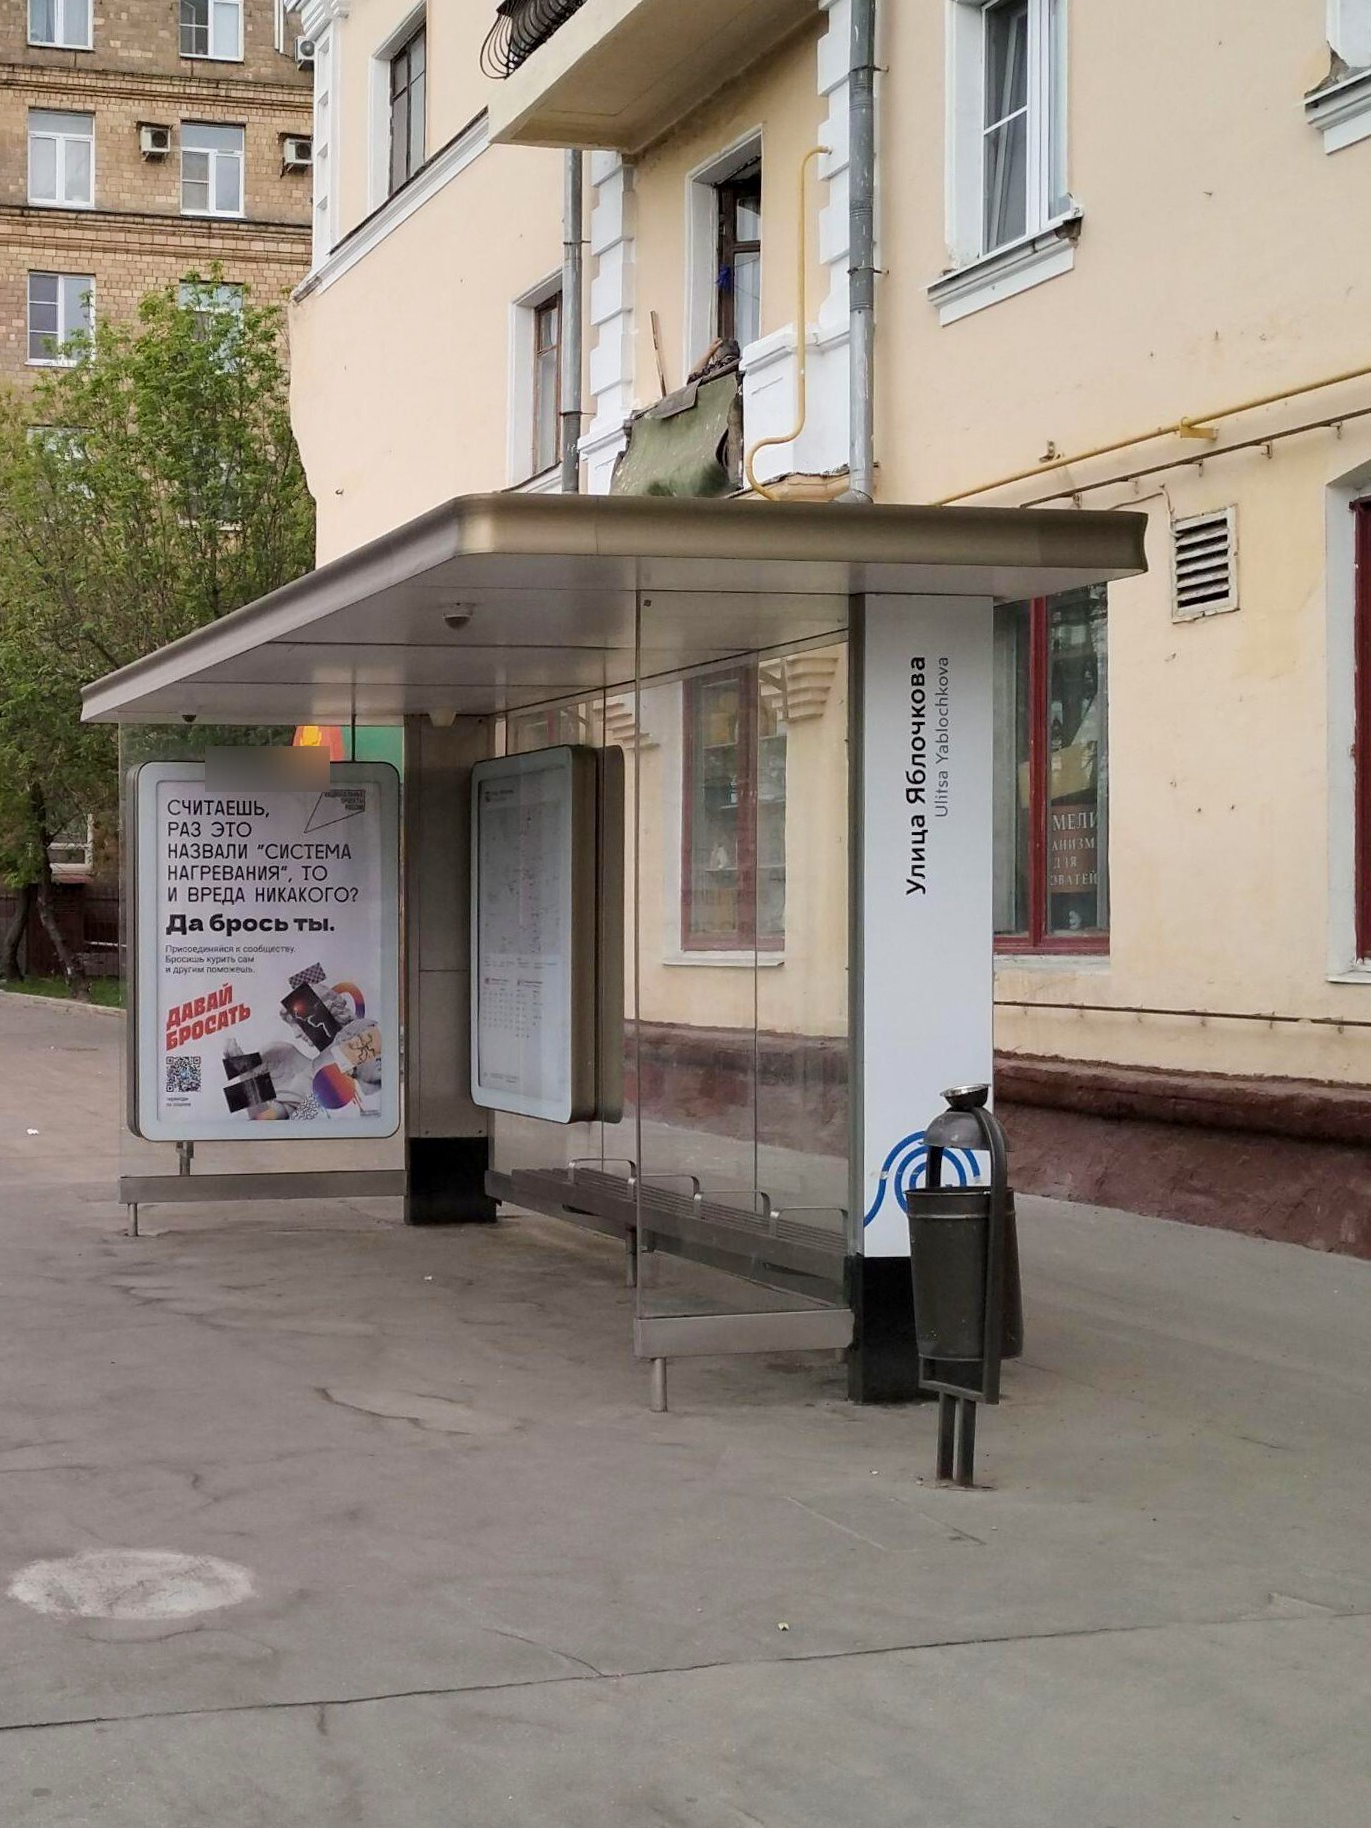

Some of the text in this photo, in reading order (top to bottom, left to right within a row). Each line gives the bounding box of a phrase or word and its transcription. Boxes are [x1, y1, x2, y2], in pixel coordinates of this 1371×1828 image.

[934, 657, 949, 817] Ulitsa Yablochkova
[905, 656, 928, 895] Улица Яблочкова
[167, 799, 270, 818] СЧИТАЕШЬ,
[167, 821, 252, 838] РАЗ ЭТО
[167, 843, 248, 859] НАЗВАЛИ
[301, 865, 328, 881] ТО
[167, 886, 359, 905] И ВРЕДА НИКАКОГО?
[165, 913, 335, 937] Да брось ты.
[165, 944, 234, 954] Присоединяйся
[165, 955, 205, 965] Бросишь
[206, 956, 236, 965] курить
[172, 967, 205, 975] другим
[166, 982, 234, 1031] ДАВАЙ
[165, 1002, 251, 1051] БРОСАТЬ
